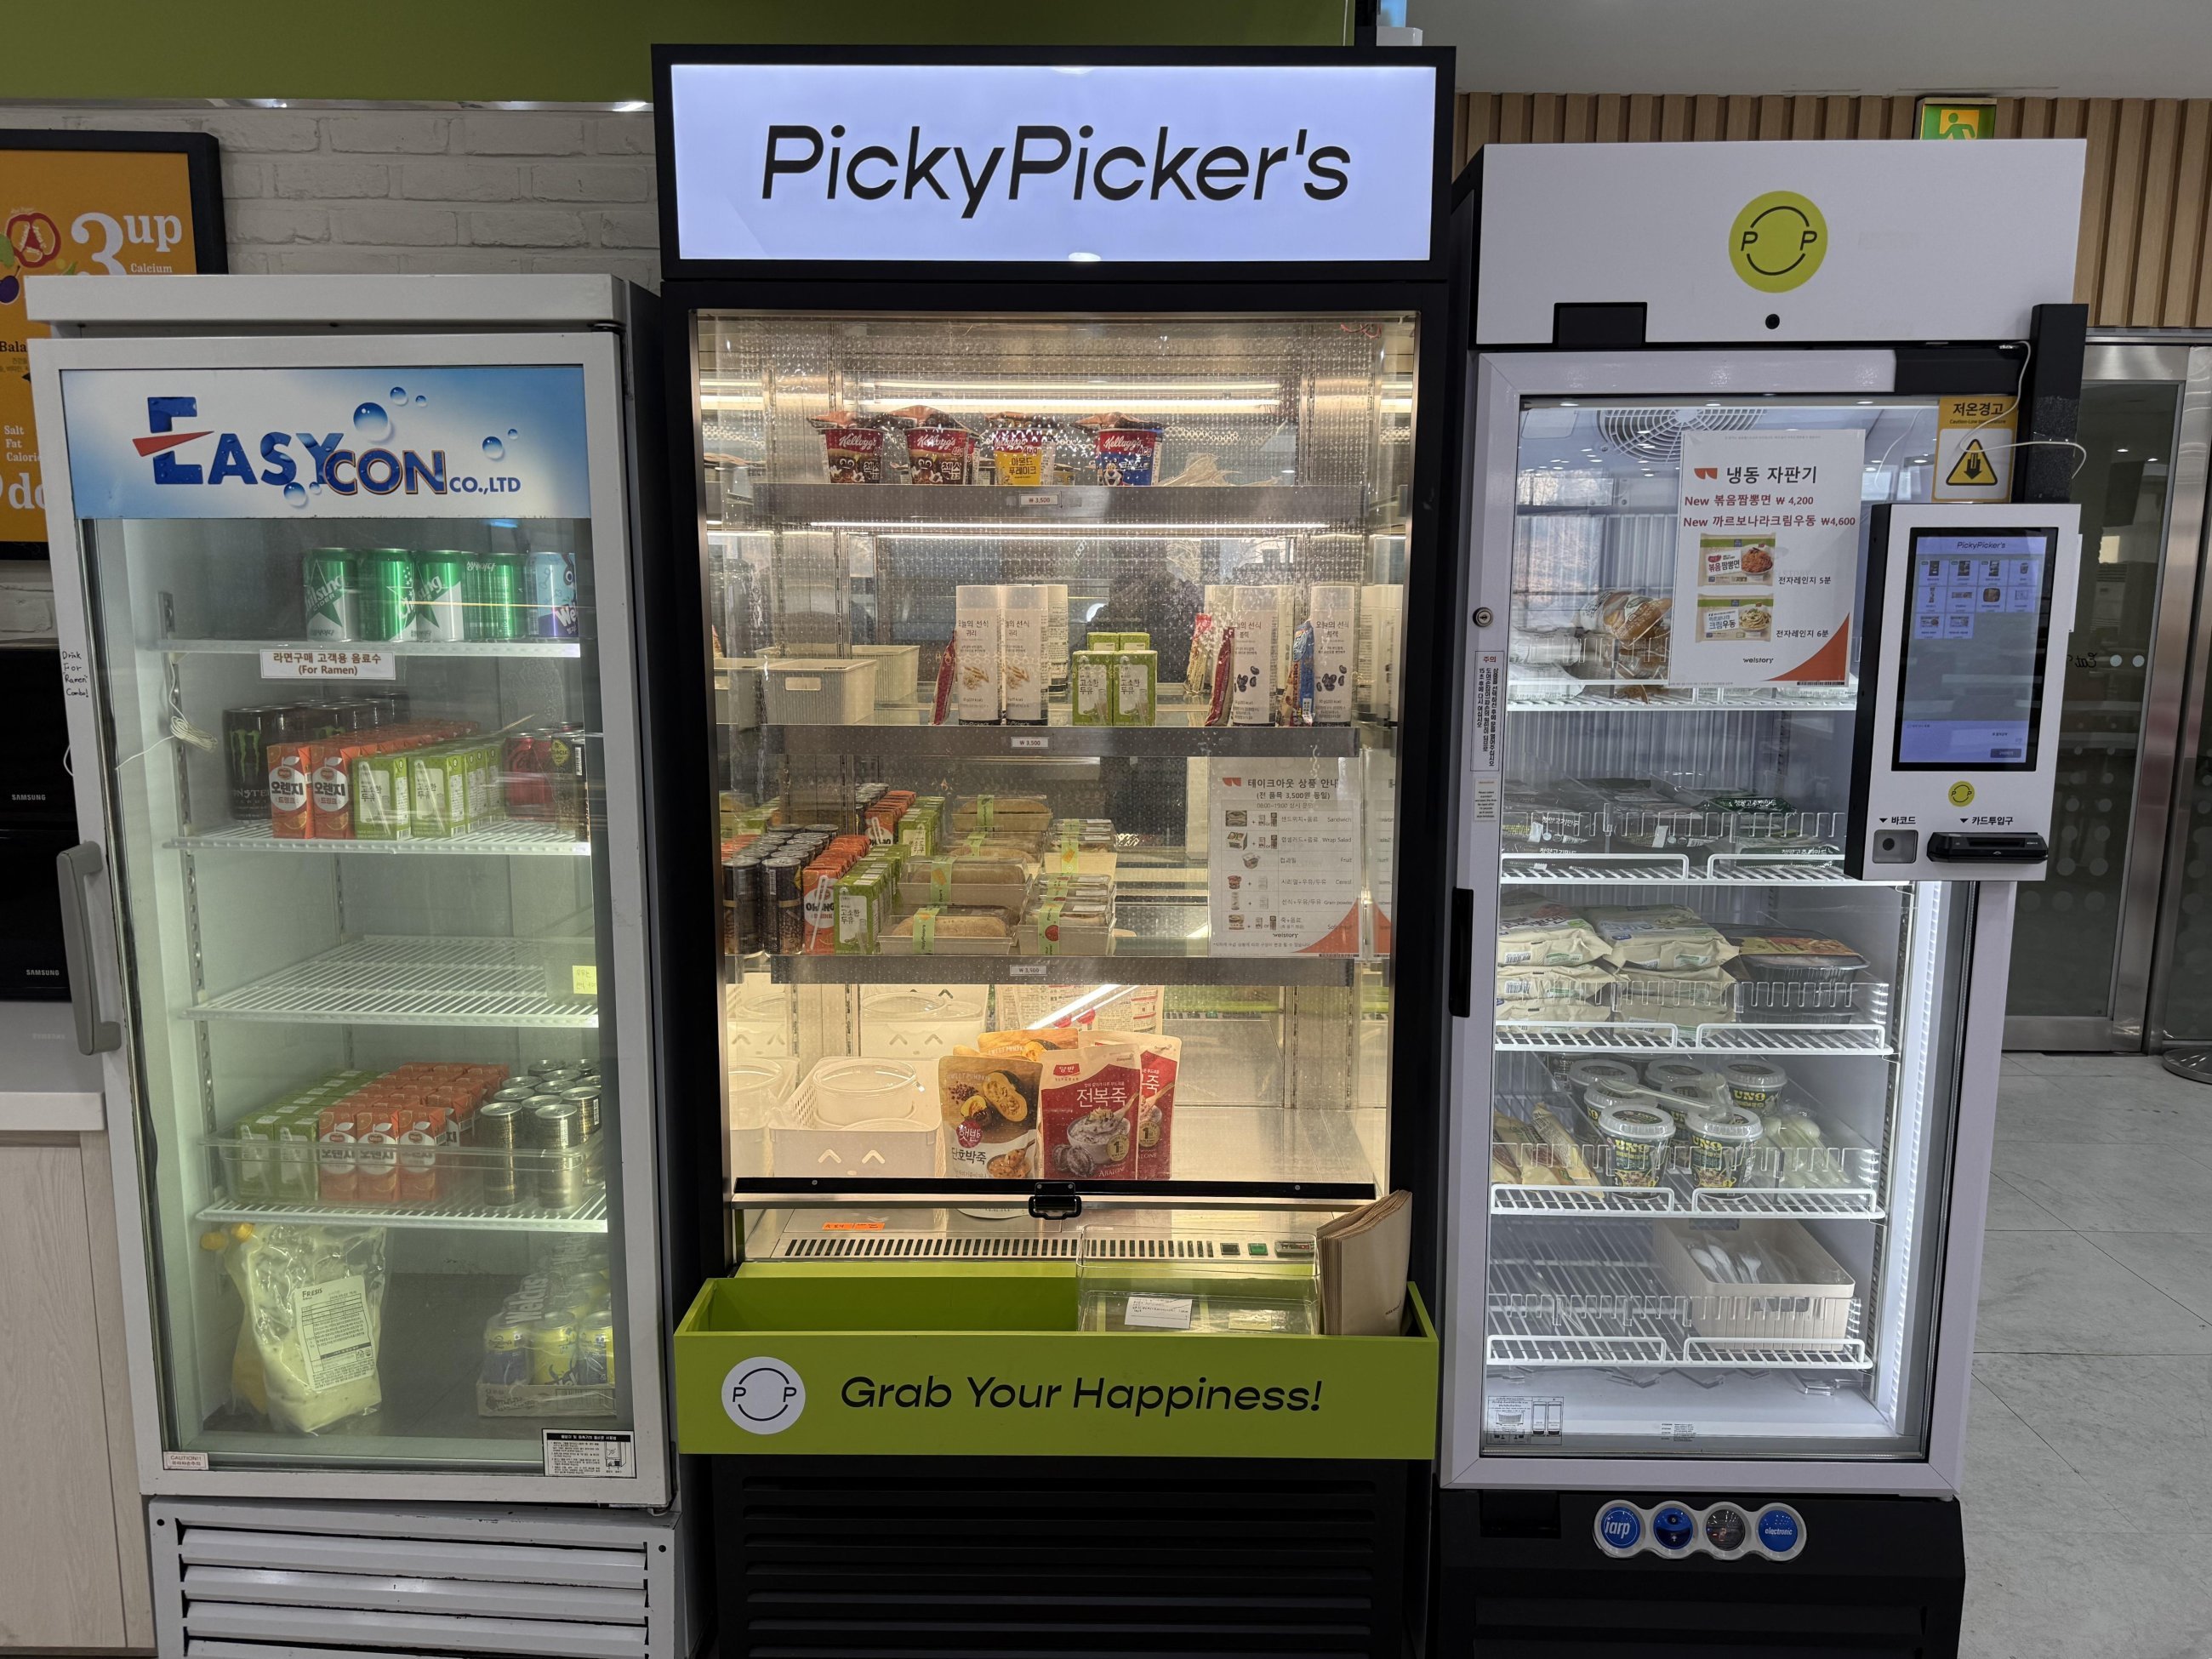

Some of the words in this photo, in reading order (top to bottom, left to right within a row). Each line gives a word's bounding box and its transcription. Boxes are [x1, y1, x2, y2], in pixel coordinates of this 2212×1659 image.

[761, 124, 1351, 219] PickyPicker's
[1741, 231, 1759, 251] P
[1799, 231, 1817, 251] P
[131, 263, 173, 273] Calcium
[1953, 402, 2004, 416] 저온경고
[4, 425, 24, 435] Salt
[6, 439, 22, 448] Fat
[839, 434, 877, 450] Kellogg's
[1105, 436, 1142, 451] Kellogg's
[1726, 467, 1759, 484] 냉동
[1767, 466, 1816, 483] 자판기
[449, 475, 521, 495] CO.,LTD
[1685, 497, 1709, 505] New
[1713, 494, 1771, 506] 볶음짬뽕면
[1788, 497, 1814, 506] 4,200
[1684, 518, 1707, 527] New
[1713, 515, 1816, 527] 까르보나라크림우동
[1821, 517, 1856, 527] ₩4,600
[1957, 541, 2006, 550] PickyPicker's
[1778, 577, 1816, 585] 전자레인지
[1776, 630, 1814, 638] 전자레인지
[62, 651, 82, 660] Drink
[273, 653, 314, 664] 라면구매
[317, 653, 347, 664] 고객용
[352, 653, 382, 664] 음료수
[63, 662, 82, 671] For
[299, 665, 317, 675] (For
[321, 665, 358, 676] Ramen)
[271, 782, 304, 795] 오렌지
[314, 782, 345, 796] 오렌지
[1247, 778, 1294, 789] 테이크아웃
[1299, 778, 1316, 789] 상품
[1891, 817, 1916, 825] 바코드
[1971, 817, 2014, 826] 카드투입구
[1076, 1087, 1127, 1108] 전복죽
[1734, 1090, 1766, 1101] UNO
[1692, 1135, 1722, 1149] UNO
[951, 1147, 987, 1165] 단호박죽
[302, 1287, 323, 1298] FRESIS
[732, 1387, 746, 1403] P
[782, 1387, 797, 1403] P
[841, 1376, 952, 1409] Grab
[966, 1377, 1062, 1409] Your
[1073, 1378, 1322, 1417] Happiness!
[1764, 1526, 1793, 1536] electronic
